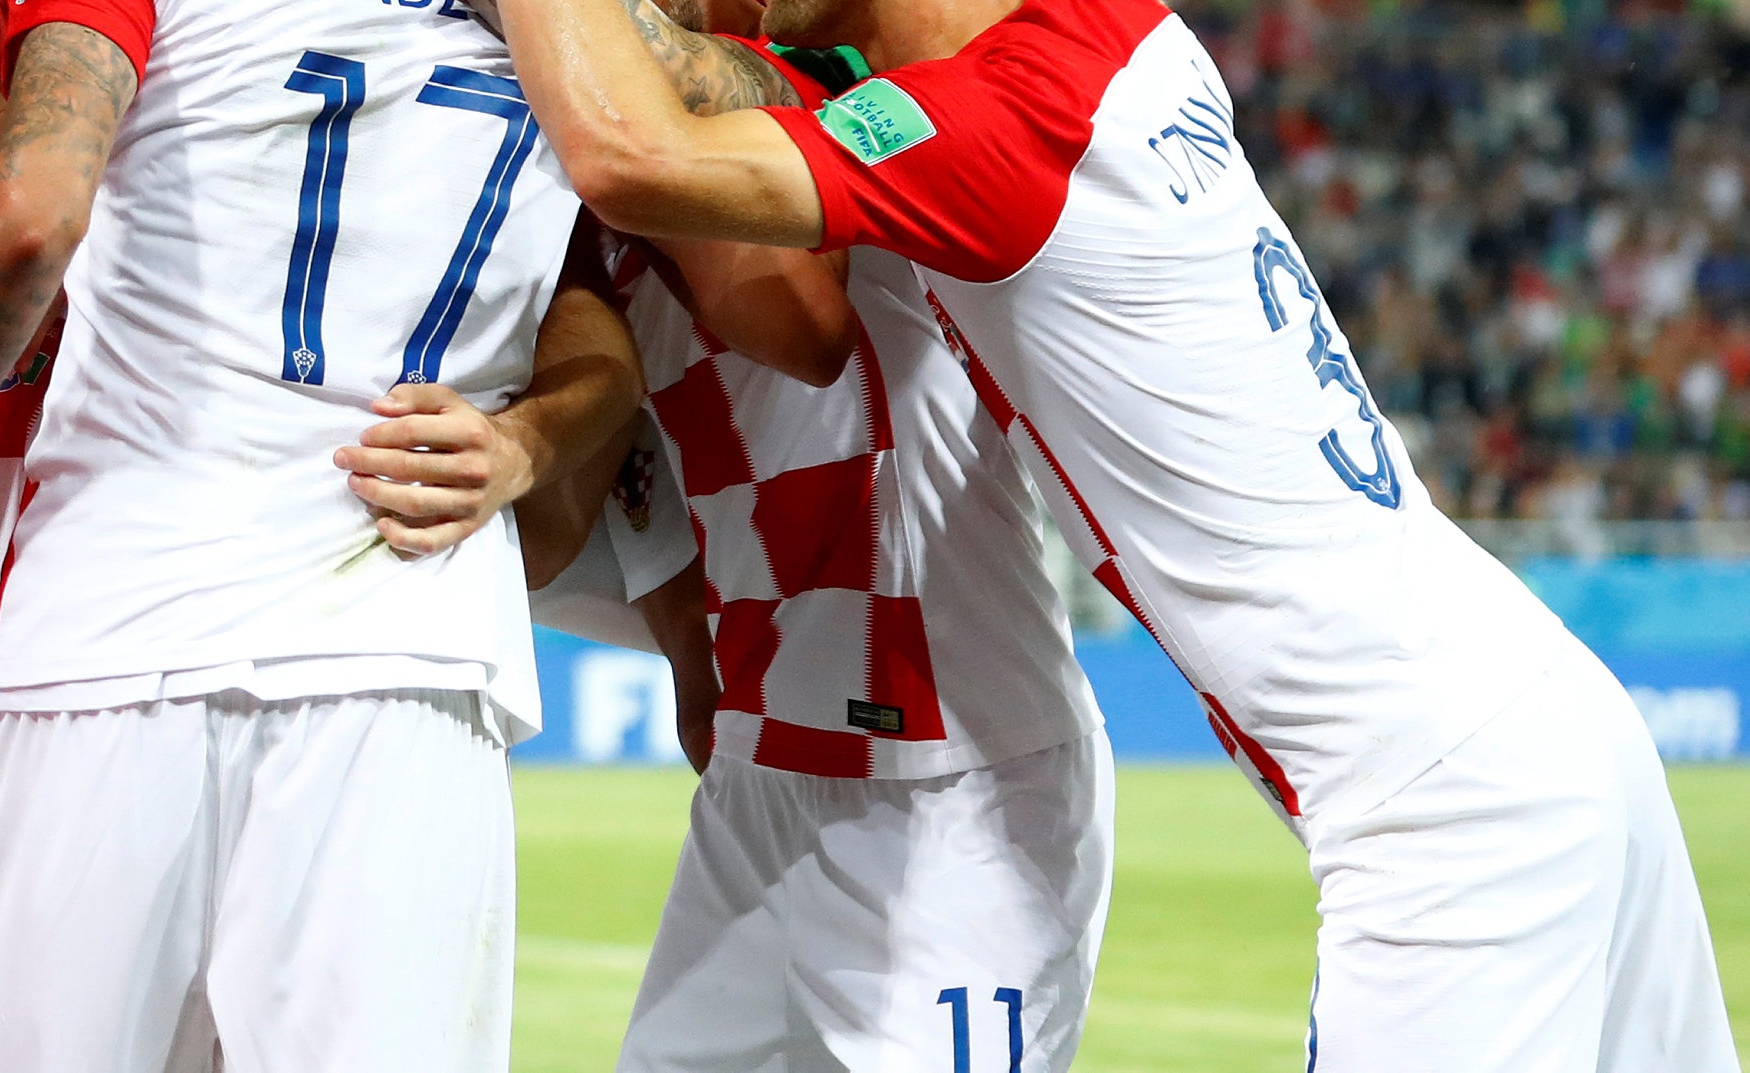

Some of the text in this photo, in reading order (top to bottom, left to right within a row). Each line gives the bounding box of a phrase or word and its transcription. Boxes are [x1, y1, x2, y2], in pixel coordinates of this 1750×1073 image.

[282, 50, 540, 391] 17
[851, 128, 873, 157] FIFA
[1253, 226, 1402, 510] 3
[936, 986, 1024, 1073] 11
